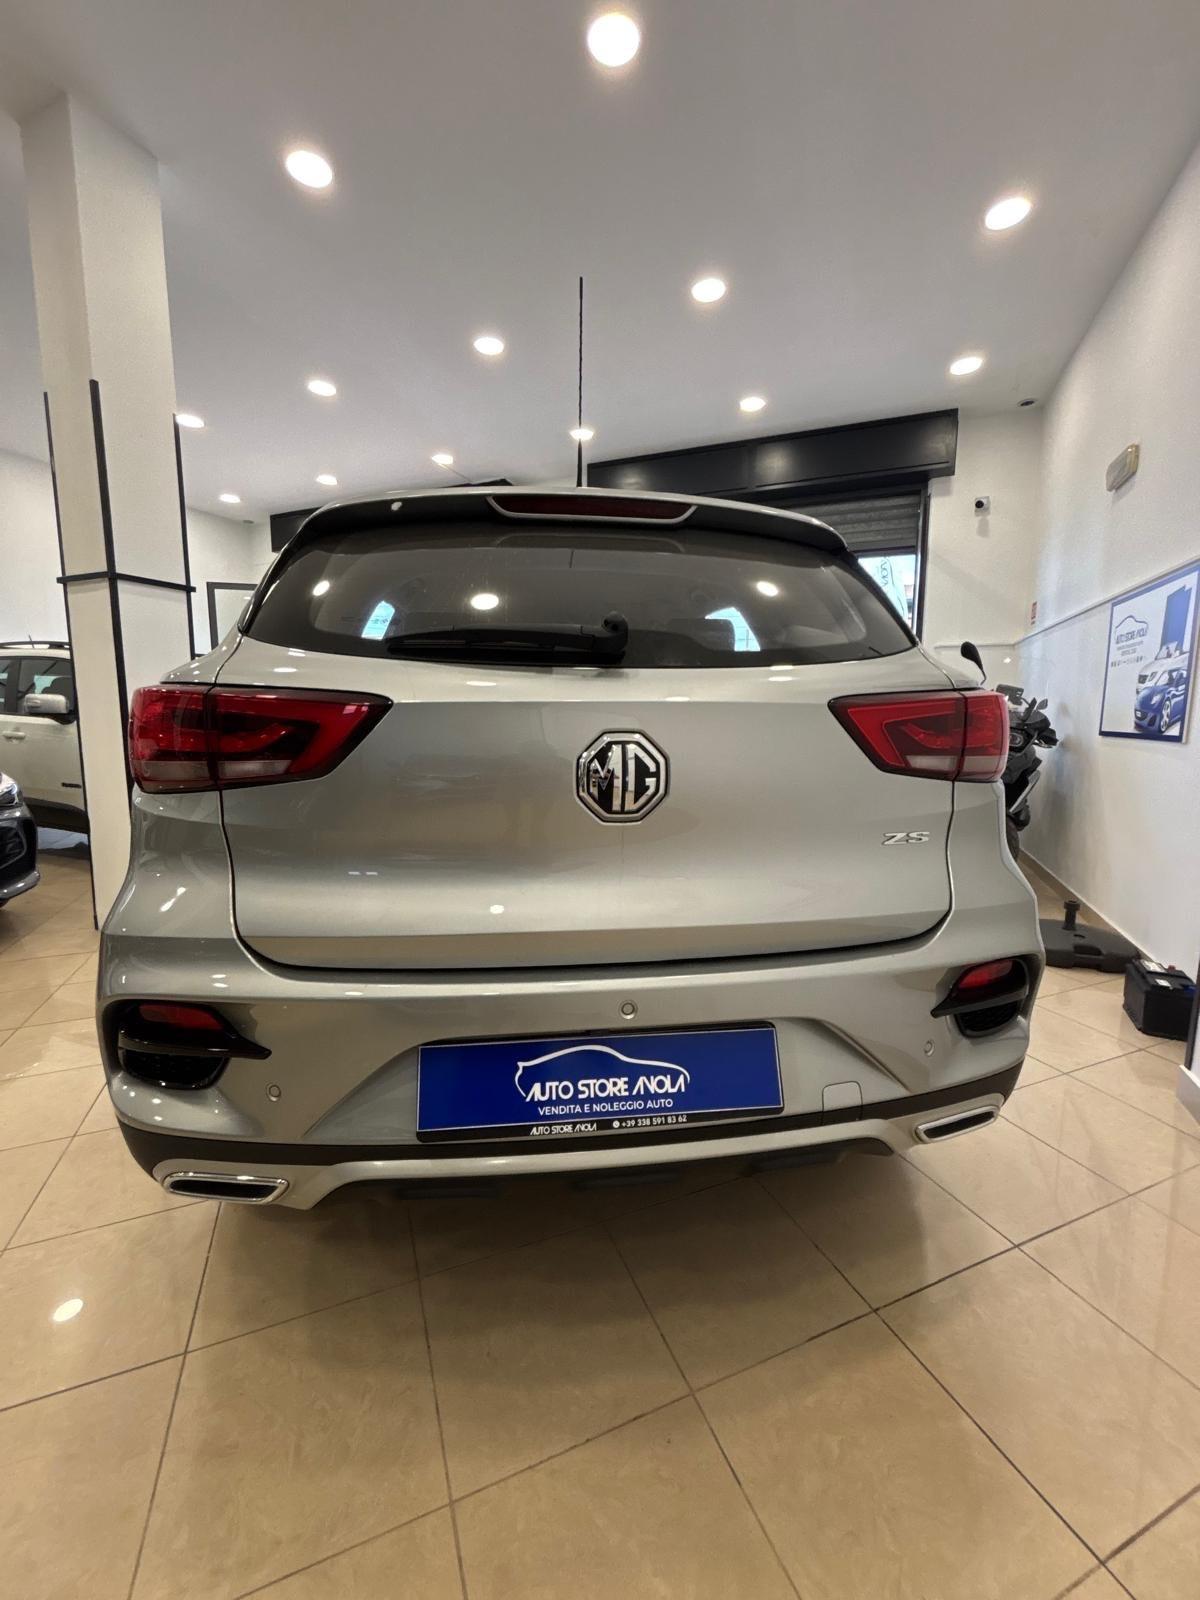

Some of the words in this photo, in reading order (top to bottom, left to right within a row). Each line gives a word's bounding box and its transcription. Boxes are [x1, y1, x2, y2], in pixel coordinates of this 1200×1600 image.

[590, 743, 656, 811] MG
[882, 831, 930, 845] ZS
[525, 1081, 574, 1102] AUTO
[577, 1077, 629, 1099] STORE
[538, 1104, 582, 1116] VENDITA
[584, 1104, 590, 1113] E
[593, 1100, 644, 1112] NOLEGGIO
[646, 1099, 673, 1109] AUTO
[621, 1120, 635, 1128] +39
[637, 1118, 651, 1126] 338
[652, 1117, 665, 1125] 591
[667, 1116, 677, 1124] 83
[530, 1126, 550, 1136] AUTO
[551, 1124, 573, 1134] STORE
